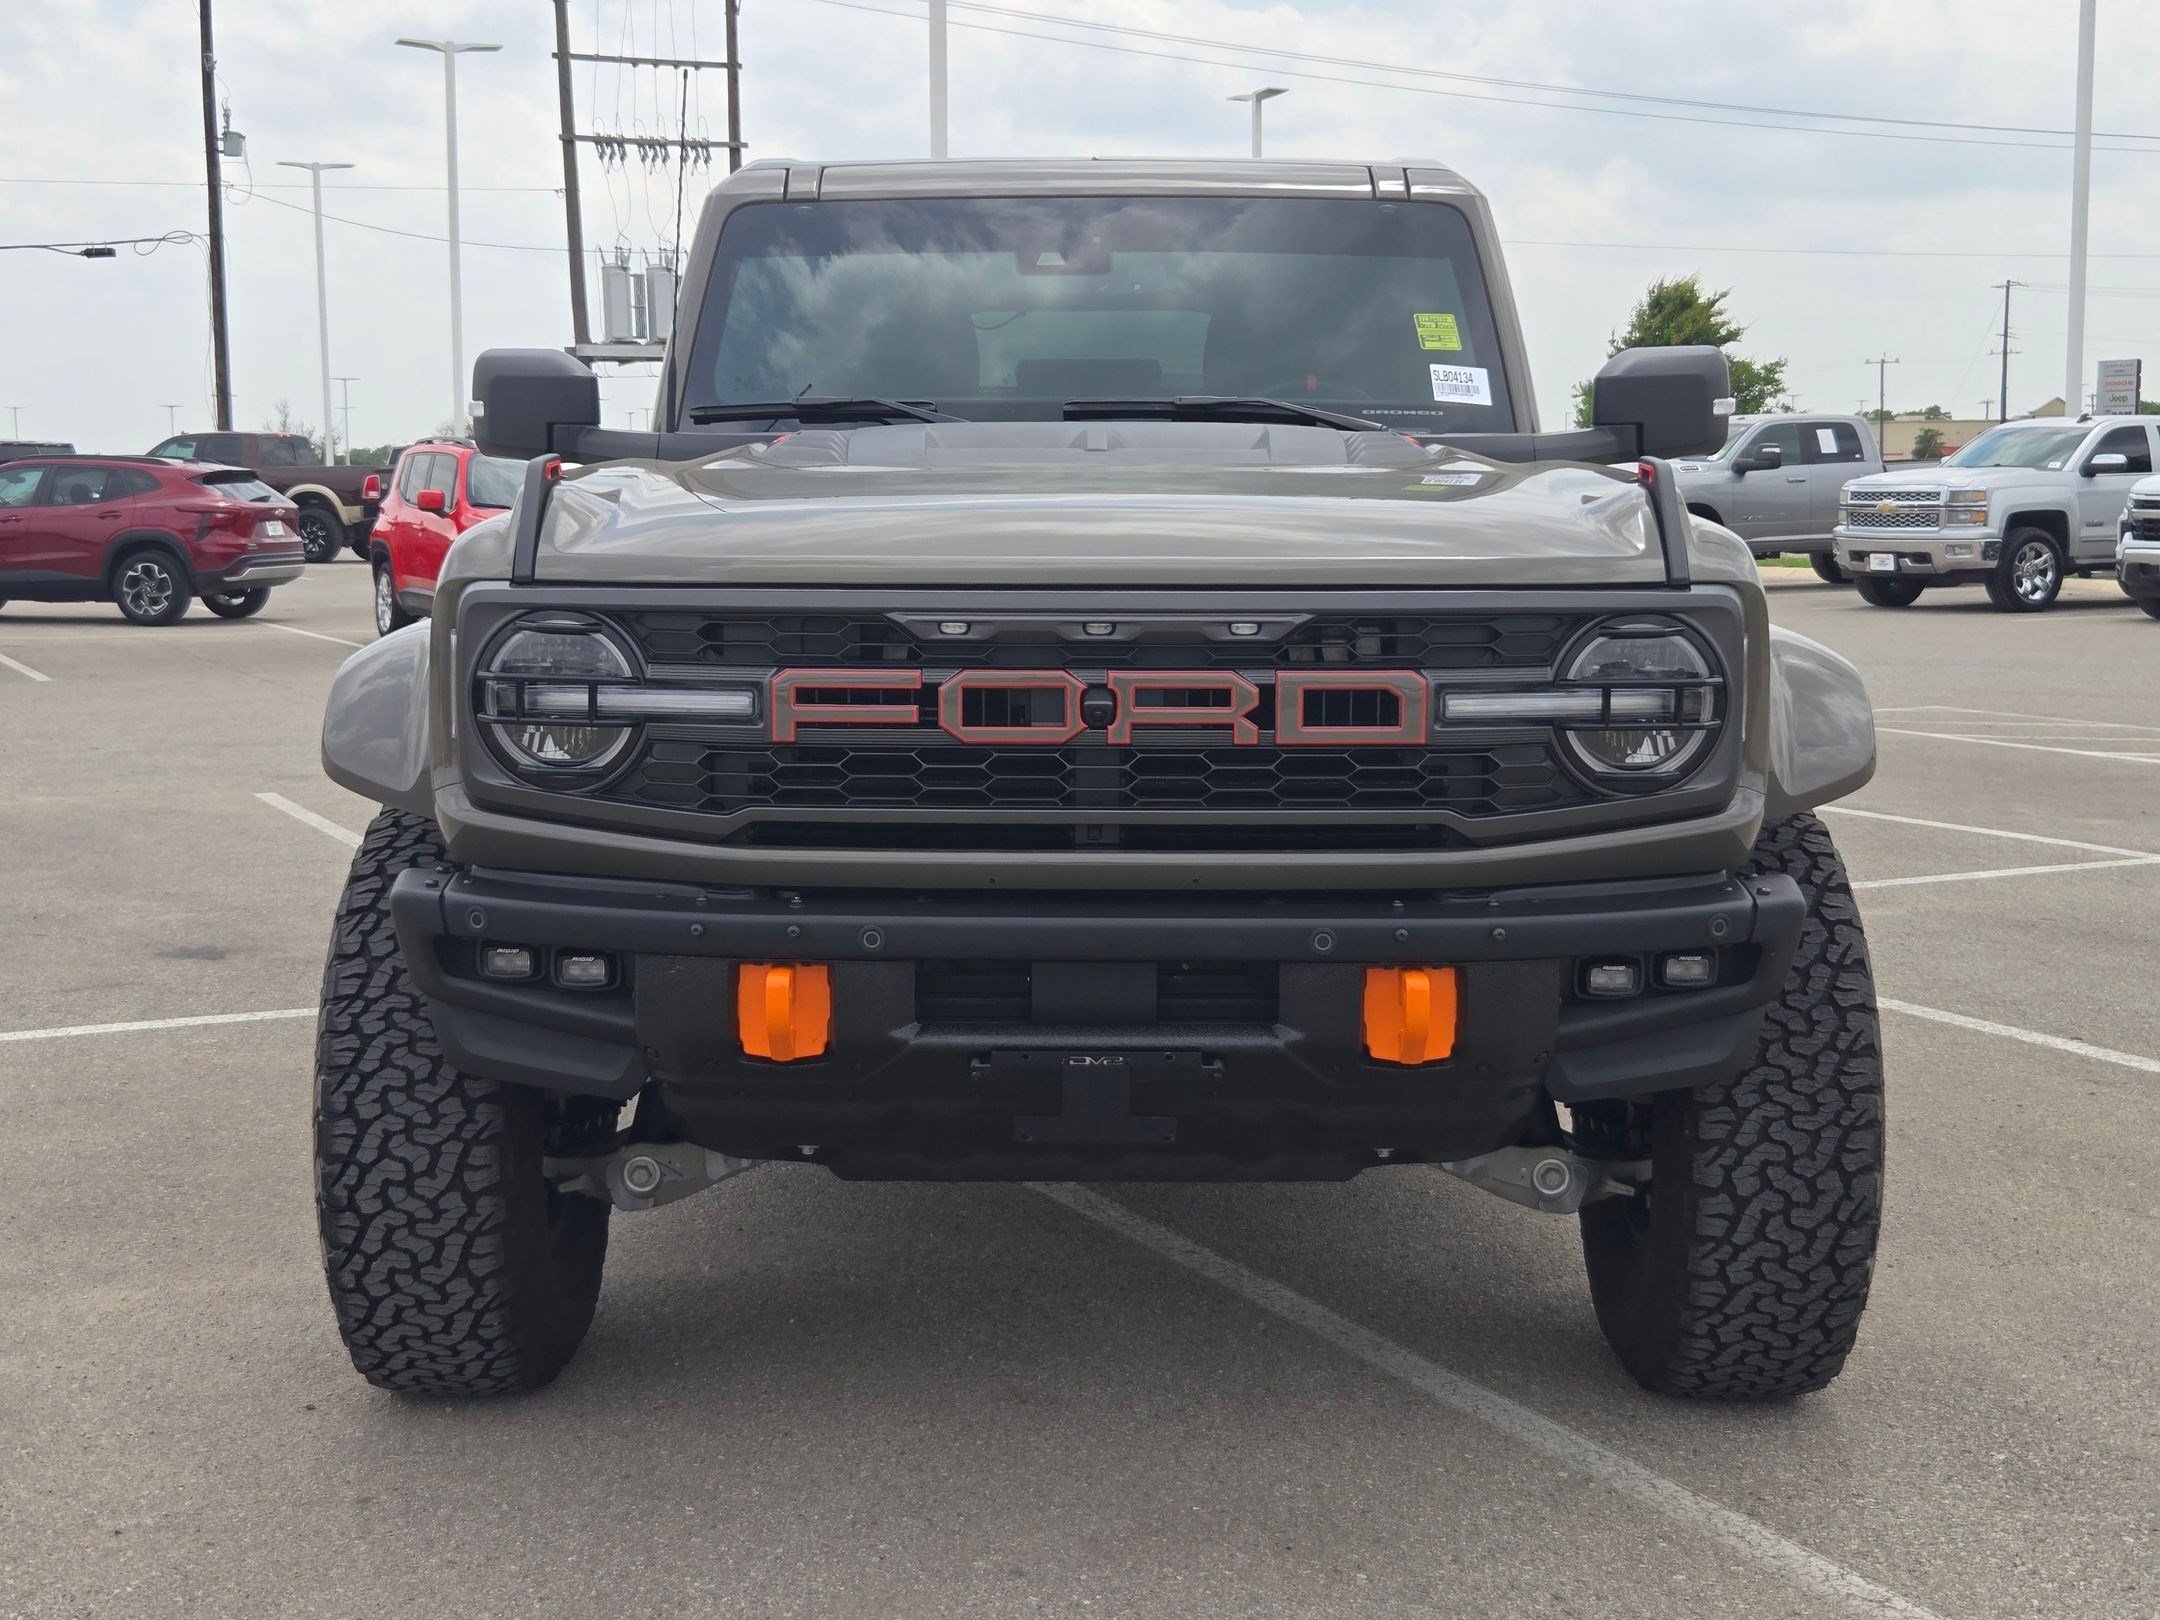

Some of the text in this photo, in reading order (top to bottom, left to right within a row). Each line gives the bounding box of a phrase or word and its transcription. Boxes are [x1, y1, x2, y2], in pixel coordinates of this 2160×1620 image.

[1432, 369, 1474, 384] SLB04134
[2109, 393, 2128, 404] Jeep
[771, 668, 1427, 745] FORD
